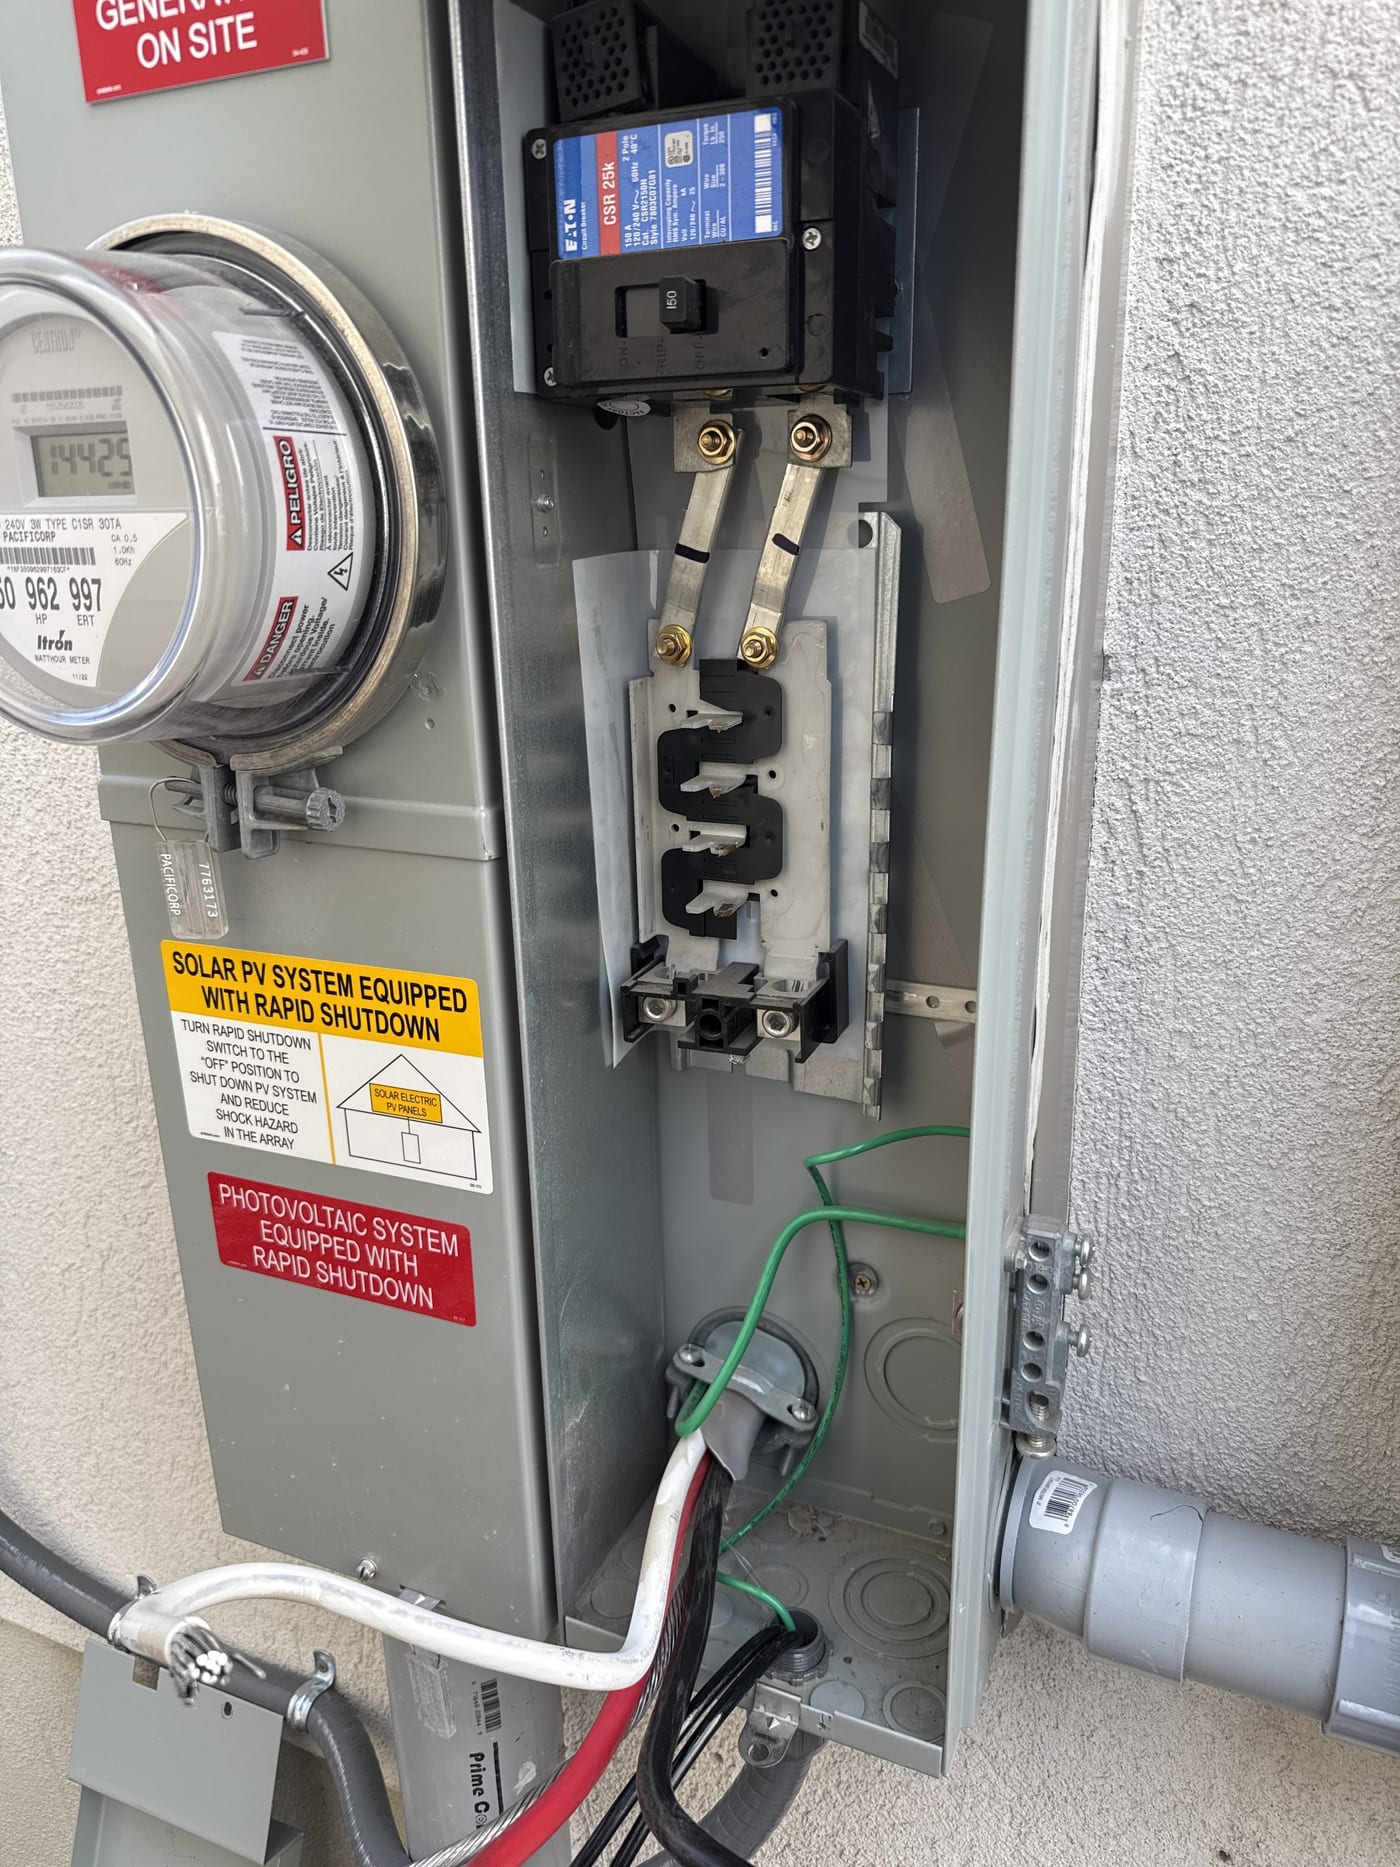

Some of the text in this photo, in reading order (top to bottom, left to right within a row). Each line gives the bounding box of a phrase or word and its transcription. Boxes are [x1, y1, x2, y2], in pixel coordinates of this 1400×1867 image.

[137, 11, 258, 69] ON SITE
[630, 133, 638, 154] 40°C
[631, 162, 639, 183] 60Hz
[602, 161, 617, 226] CSR 25k
[640, 178, 648, 222] CSR2150N
[680, 187, 687, 197] kA
[563, 199, 578, 252] EATON
[688, 187, 697, 240] 120/240 25
[633, 212, 641, 247] 120/240
[650, 224, 660, 245] Style
[719, 216, 727, 237] CU/AL
[625, 232, 633, 248] 150
[666, 290, 677, 309] 150
[279, 440, 301, 524] PELIGRO
[3, 531, 56, 542] PACIFICORP
[5, 518, 122, 530] 240V 3W TYPE C1SR 30TA
[111, 534, 138, 543] CA 0.5
[115, 558, 133, 566] 60Hz
[25, 576, 60, 611] 962
[69, 577, 102, 612] 997
[35, 614, 95, 626] HP ERT
[296, 604, 309, 633] power
[37, 630, 73, 651] Itron
[260, 601, 293, 665] DANGER
[34, 655, 91, 665] WATTHOUR METER
[72, 673, 88, 681] 11/22
[161, 853, 181, 916] PACIFICORP
[199, 862, 218, 918] 7763173
[172, 951, 468, 1013] SOLAR PV SYSTEM EQUIPPED
[201, 985, 440, 1042] WITH RAPID SHUTDOWN
[180, 1019, 312, 1050] TURN RAPID SHUTDOWN
[206, 1040, 289, 1065] SWITCH TO THE
[231, 1061, 282, 1081] POSITION
[283, 1069, 300, 1084] TO
[190, 1071, 317, 1103] SHUT DOWN PV SYSTEM
[374, 1088, 438, 1108] SOLAR ELECTRIC
[220, 1093, 289, 1116] AND REDUCE
[386, 1102, 428, 1118] PV PANELS
[216, 1108, 299, 1134] SHOCK HAZARD
[224, 1126, 235, 1139] IN
[236, 1129, 259, 1143] THE
[259, 1133, 295, 1150] ARRAY
[218, 1183, 459, 1257] PHOTOVOLTAIC SYSTEM
[260, 1219, 419, 1277] EQUIPPED WITH
[252, 1245, 434, 1310] RAPID SHUTDOWN
[469, 1752, 487, 1798] Prime
